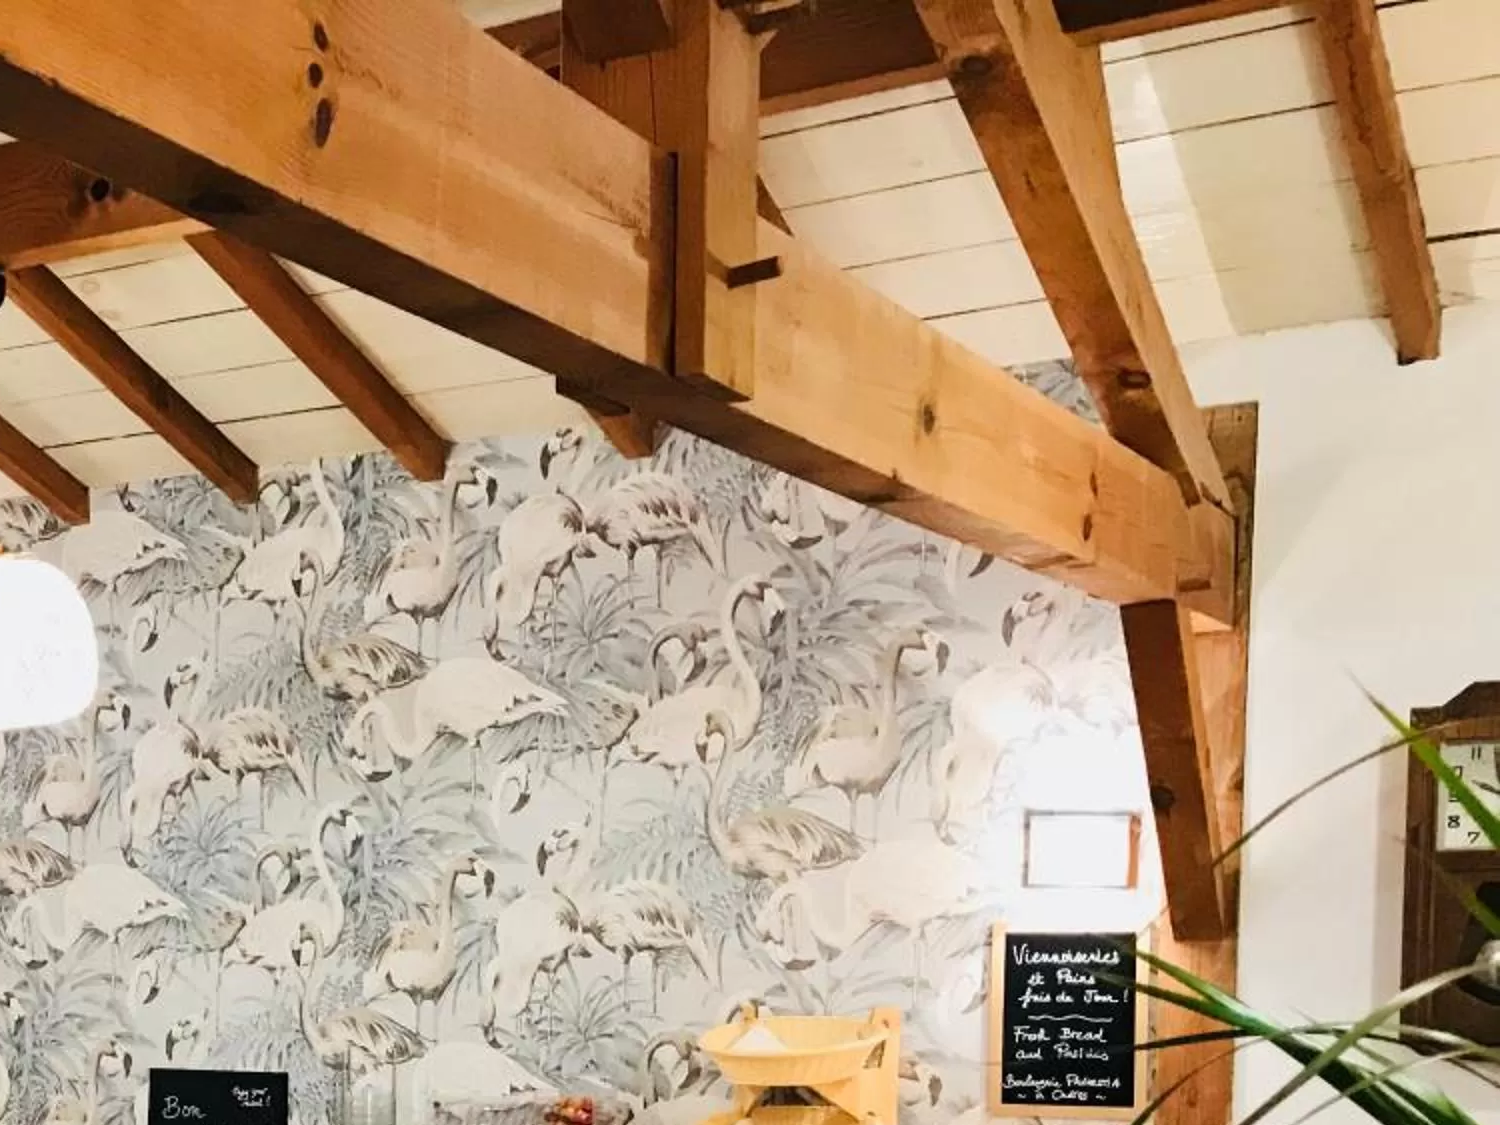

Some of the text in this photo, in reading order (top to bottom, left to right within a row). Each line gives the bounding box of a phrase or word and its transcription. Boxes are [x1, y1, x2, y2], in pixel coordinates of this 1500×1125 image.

[1447, 815, 1461, 829] 8
[1467, 831, 1480, 845] 7
[1013, 943, 1121, 966] Viennoiseries
[1059, 1027, 1108, 1043] Bread
[162, 1095, 208, 1119] Bon
